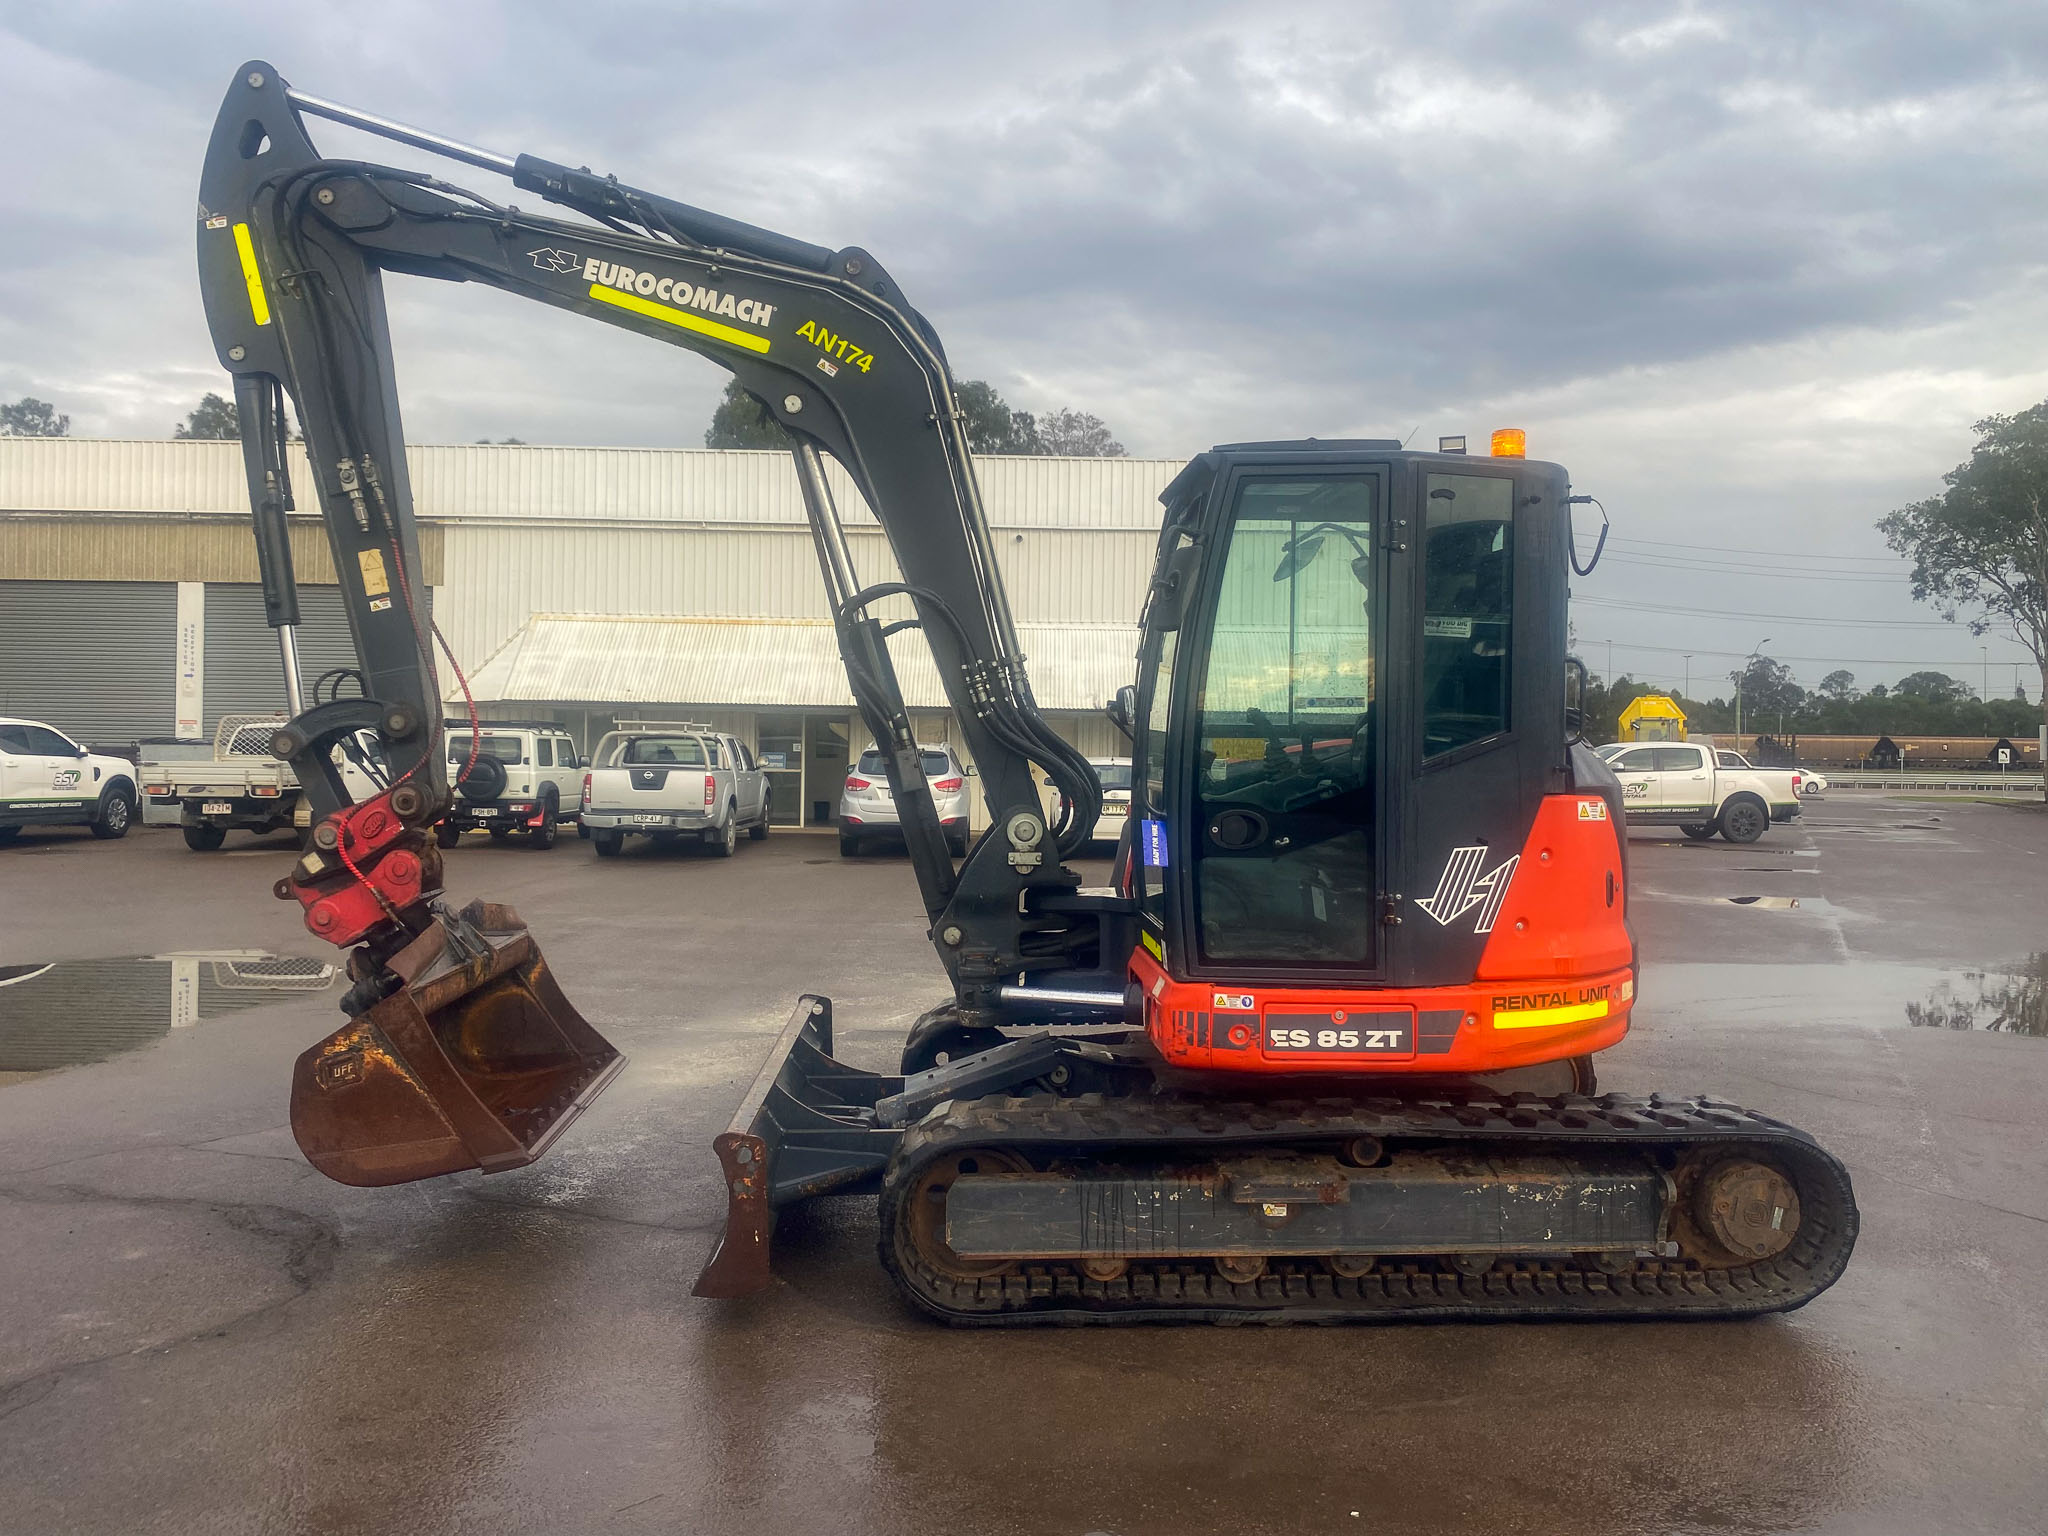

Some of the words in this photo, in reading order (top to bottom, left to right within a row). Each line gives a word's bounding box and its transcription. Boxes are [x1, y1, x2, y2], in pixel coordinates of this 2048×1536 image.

[582, 256, 773, 327] EUROCOMACH
[795, 320, 875, 374] AN174
[1151, 824, 1159, 836] HIRE
[1151, 836, 1159, 848] FOR
[1491, 991, 1573, 1011] RENTAL
[1578, 984, 1611, 1004] UNIT
[1270, 1029, 1311, 1048] ES
[1317, 1030, 1359, 1048] 85
[1365, 1030, 1403, 1048] ZT
